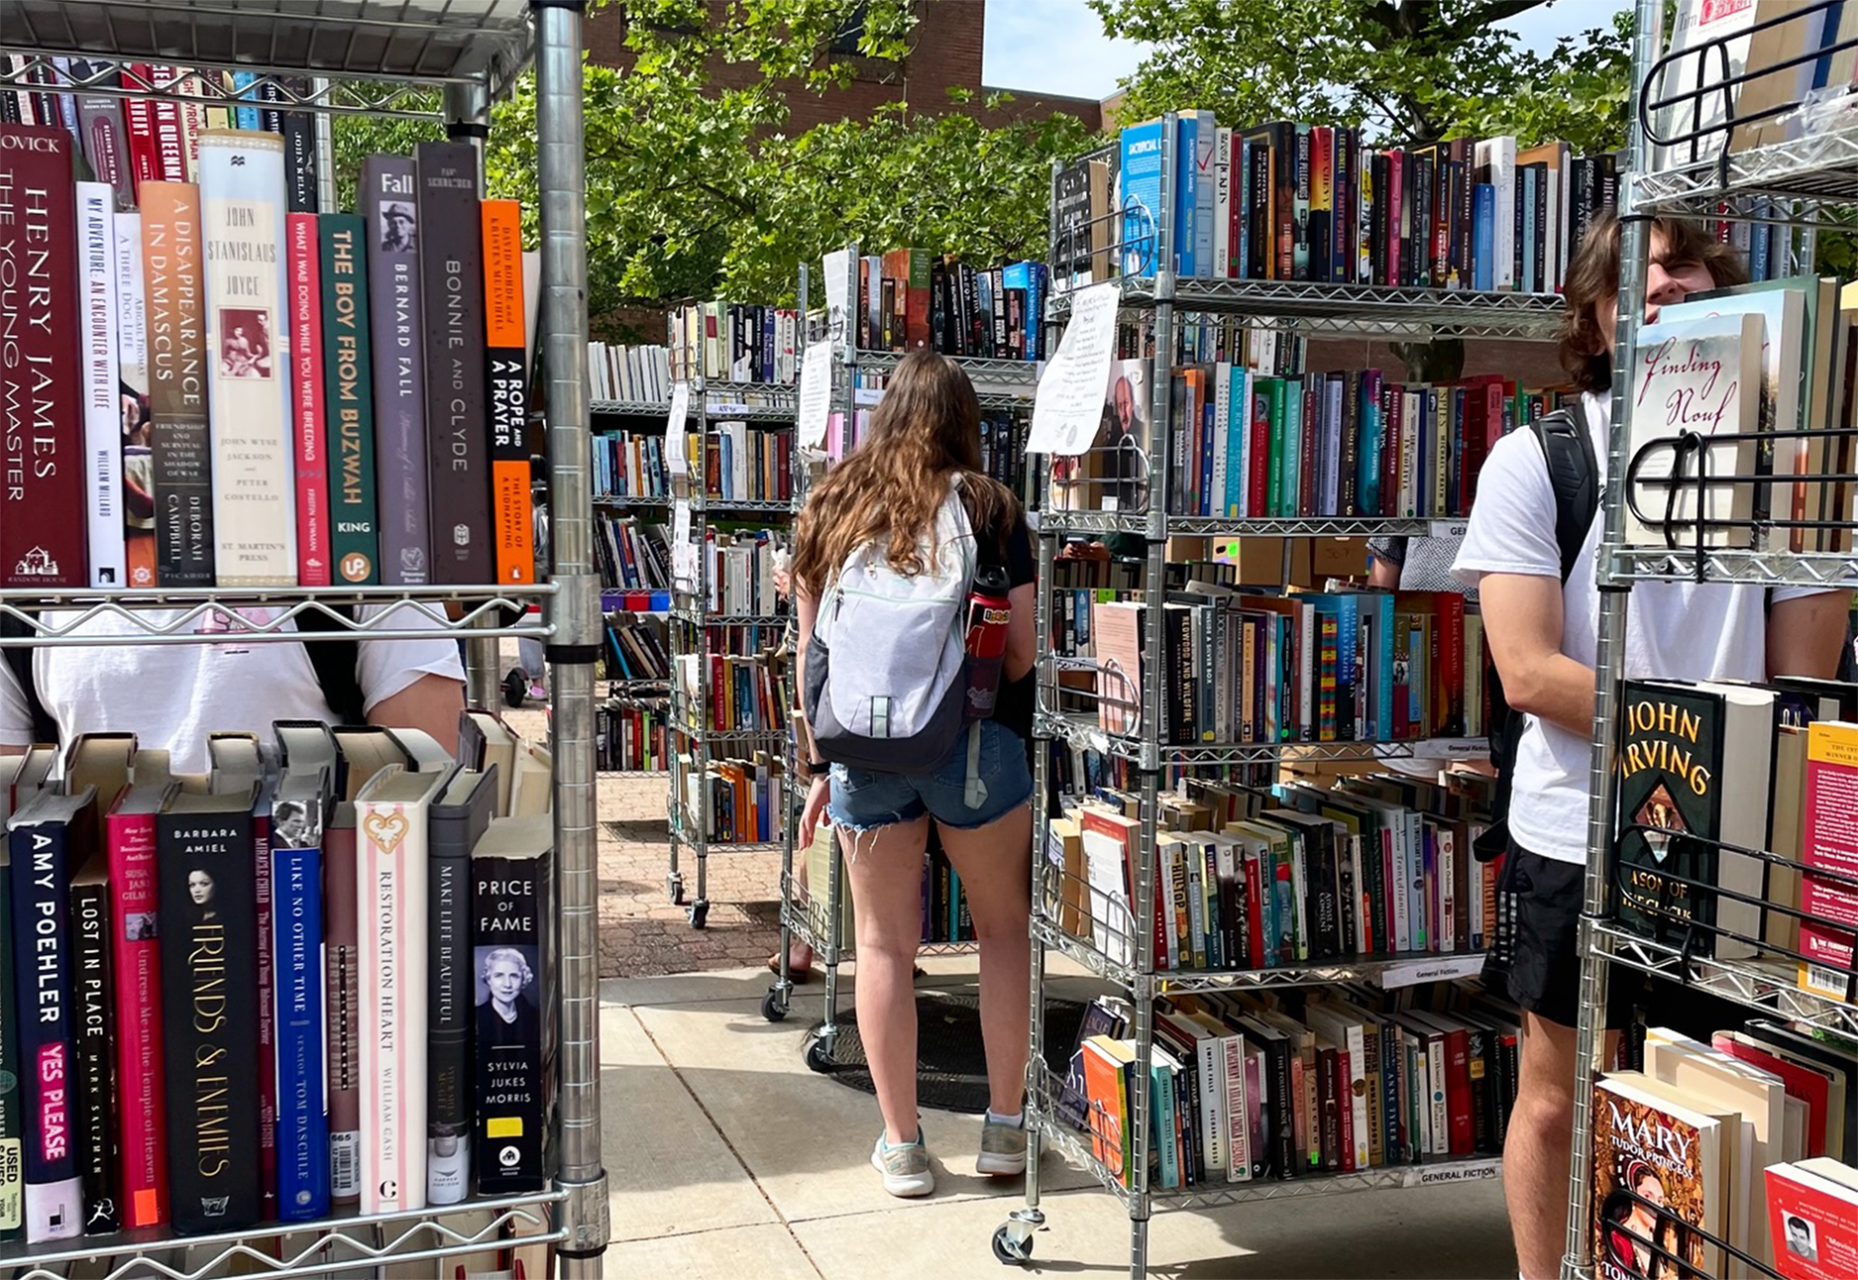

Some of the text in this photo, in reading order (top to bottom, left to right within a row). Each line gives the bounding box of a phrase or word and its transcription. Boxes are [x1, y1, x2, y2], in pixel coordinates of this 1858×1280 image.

[1, 134, 60, 153] OVICK
[1338, 134, 1346, 147] LEE
[294, 131, 305, 204] JOHN KELLY
[381, 173, 413, 194] Fall
[1298, 136, 1308, 199] GEORGE PELECANOS
[87, 198, 104, 213] MY
[226, 207, 255, 227] JOHN
[1337, 195, 1345, 218] PARTY
[208, 243, 276, 264] STANISLAUS
[296, 222, 306, 250] WHAT
[490, 217, 501, 266] KRISTEN
[501, 227, 512, 258] DAVID
[90, 281, 105, 294] AN
[119, 235, 134, 350] A THREE DOG LIFE
[226, 276, 259, 296] JOYCE
[298, 261, 308, 283] WAS
[149, 223, 173, 381] IN DAMASCUS
[173, 199, 201, 405] A DISAPPEARANCE
[298, 285, 309, 320] DOING
[395, 264, 411, 347] BERNARD
[0, 168, 24, 502] THE YOUNG MASTER
[24, 187, 57, 478] HENRY JAMES
[91, 298, 108, 355] ENCOUNTER
[134, 297, 146, 377] ABIGAIL THOMAS
[299, 323, 311, 354] WHILE
[92, 359, 109, 385] WITH
[300, 357, 312, 376] YOU
[333, 230, 362, 503] THE BOY FROM BUZWAH
[398, 357, 413, 397] FALL
[445, 260, 468, 471] BONNIE AND CLYDE
[93, 388, 110, 409] LIFE
[301, 380, 313, 408] WERE
[492, 361, 509, 446] A PRAYER
[508, 360, 524, 447] A ROPE AND
[1439, 392, 1448, 427] SPIES
[221, 438, 247, 446] JOHN
[227, 453, 272, 461] JACKSON
[302, 411, 315, 462] BREEDING
[97, 450, 111, 517] WILLIAM WILLARD
[224, 493, 279, 501] COSTELLO
[168, 494, 181, 563] CAMPBELL
[189, 496, 203, 561] DEBORAH
[337, 522, 371, 532] KING
[503, 486, 511, 549] KIDNAPPING
[514, 499, 522, 535] STORY
[516, 539, 523, 548] OF
[1205, 610, 1213, 635] INSIDE
[1182, 616, 1192, 723] REDWOOD AND WILDFIRE
[1205, 668, 1213, 684] BOX
[1628, 700, 1702, 743] JOHN
[1612, 740, 1711, 796] IRVING
[174, 829, 237, 838] BARBARA
[185, 844, 227, 853] AMIEL
[254, 838, 269, 903] MIRACLE CHILD
[478, 880, 532, 895] PRICE
[480, 917, 531, 932] FAME
[497, 901, 513, 912] OF
[32, 834, 60, 1022] AMY POEHLER
[291, 858, 306, 1012] LIKE NO OTHER TIME
[440, 866, 452, 1024] MAKE LIFE BEAUTIFUL
[81, 898, 103, 1037] LOST IN PLACE
[138, 949, 150, 1002] Undress
[380, 871, 393, 1051] RESTORATION HEART
[1417, 969, 1438, 978] General
[142, 1046, 152, 1066] the
[188, 924, 230, 1177] FRIENDS & ENEMIES
[487, 1061, 529, 1072] SYLVIA
[42, 1045, 65, 1160] YES PLEASE
[140, 1070, 155, 1117] Temple
[383, 1067, 392, 1122] WILLIAM
[485, 1093, 531, 1104] MORRIS
[491, 1077, 526, 1088] JUKES
[89, 1054, 102, 1174] MARK SALZMAN
[296, 1035, 308, 1179] SENATOR TOM DASCHLE
[1387, 1072, 1397, 1142] ANNE TYLER
[1608, 1101, 1692, 1165] MARY
[6, 1147, 18, 1182] USED
[145, 1136, 156, 1184] Heaven
[1421, 1167, 1496, 1183] GENERAL FICTION
[1610, 1135, 1693, 1180] TUDOR PRINCESS
